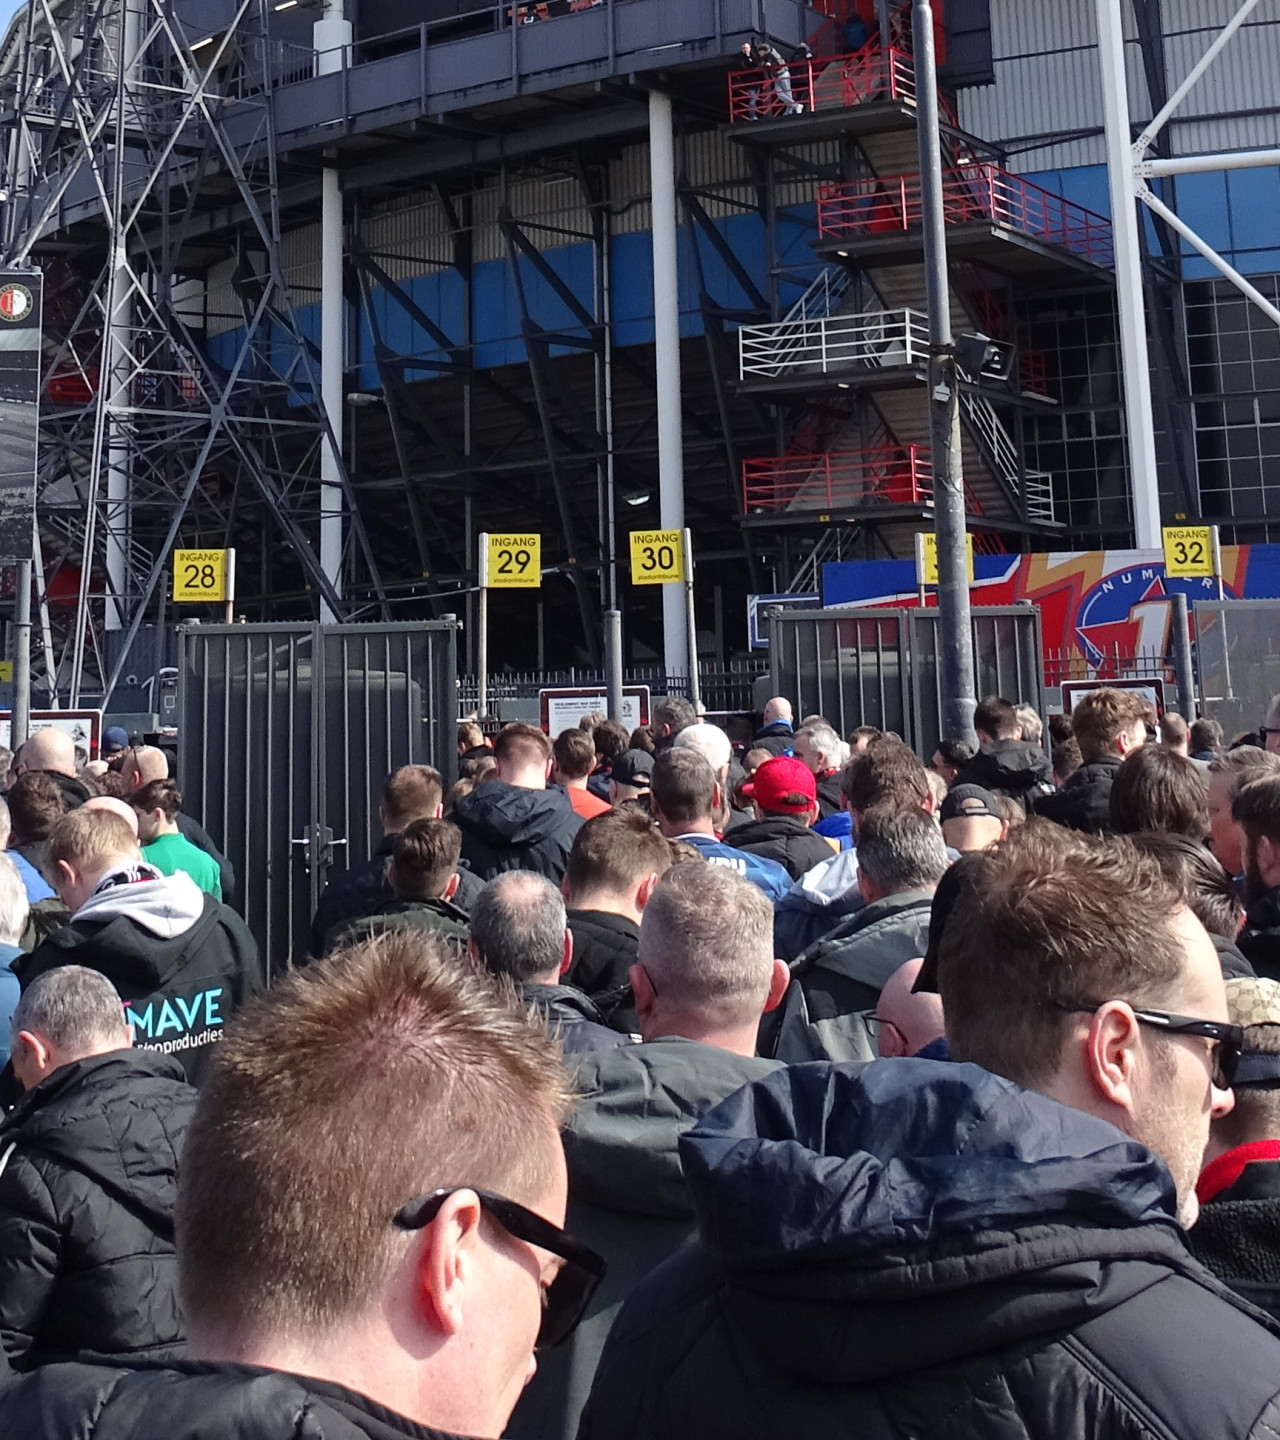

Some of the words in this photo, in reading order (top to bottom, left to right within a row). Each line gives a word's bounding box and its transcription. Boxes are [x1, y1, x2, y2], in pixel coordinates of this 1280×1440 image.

[634, 534, 678, 544] INGANG
[1166, 530, 1208, 539] INGANG
[492, 537, 536, 547] INGANG
[179, 552, 220, 562] INGANG
[1174, 542, 1204, 564] 32
[497, 550, 530, 574] 29
[641, 546, 674, 571] 30
[184, 564, 216, 588] 28
[494, 576, 535, 584] stadiontribune
[178, 590, 220, 598] stadiontribune
[126, 988, 224, 1041] MAVE
